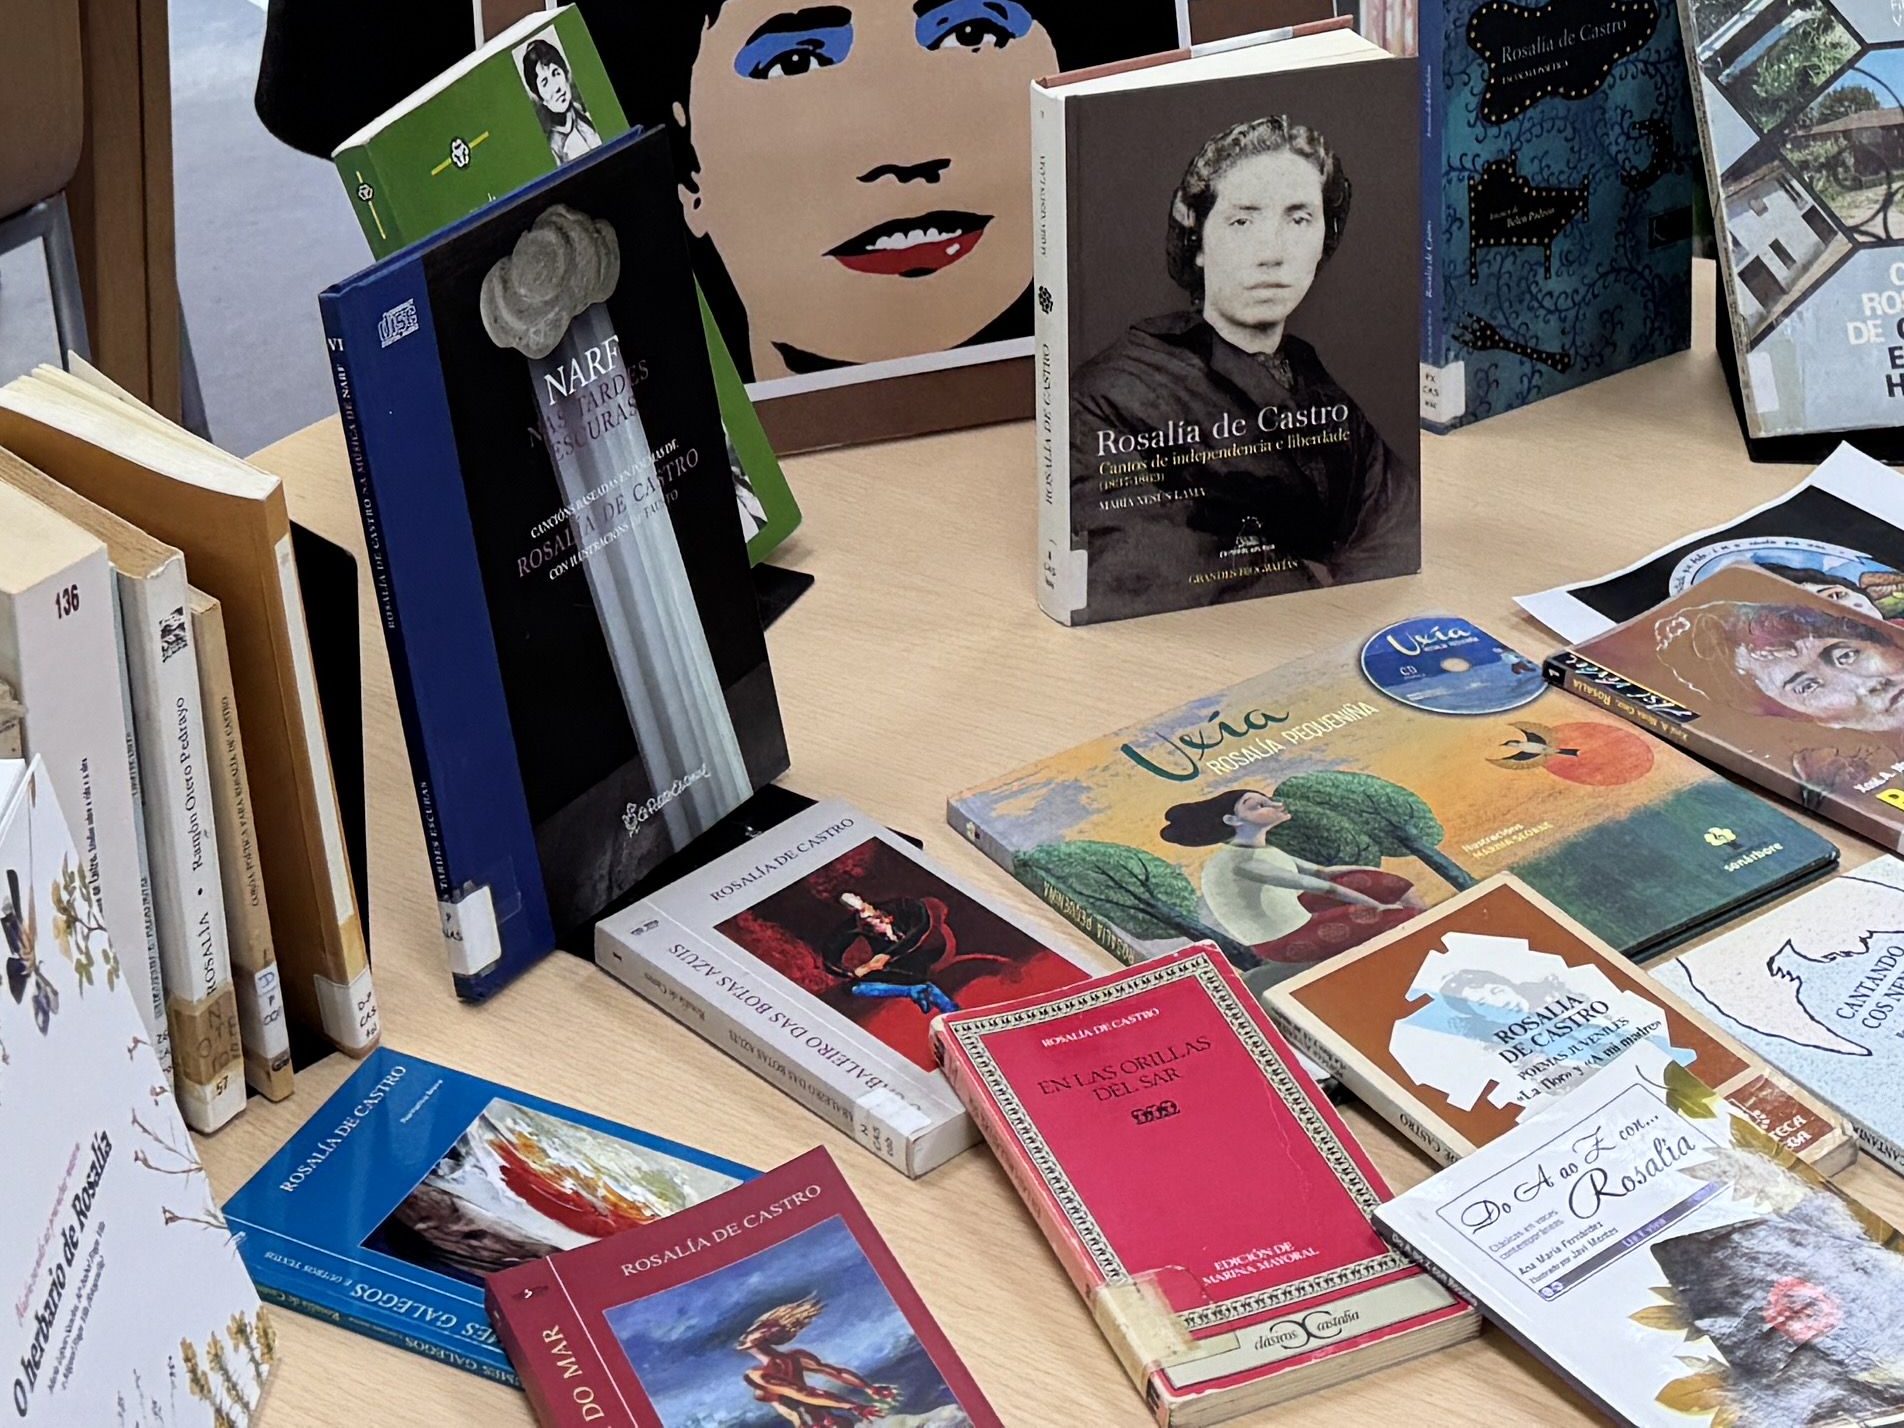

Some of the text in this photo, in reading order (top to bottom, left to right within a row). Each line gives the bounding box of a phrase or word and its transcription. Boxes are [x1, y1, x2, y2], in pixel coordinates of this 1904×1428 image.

[1847, 316, 1885, 346] DE
[544, 335, 619, 405] NARF
[1098, 404, 1348, 456] Rosalía de Castro
[1100, 460, 1147, 475] Cantos
[1151, 454, 1168, 468] de
[1173, 442, 1271, 465] independencia
[1276, 438, 1284, 449] e
[55, 584, 79, 619] 136
[1120, 704, 1290, 782] Uxía
[1206, 699, 1379, 776] ROSALÍA PEQUENIÑA
[709, 816, 855, 902] ROSALÍA DE CASTRO
[669, 943, 808, 1038] DAS BOTAS AZUIS
[1836, 946, 1904, 1019] CANTANDO
[1040, 1029, 1091, 1048] ROSALÍA
[1109, 1007, 1160, 1030] CASTRO
[1494, 995, 1584, 1045] ROSALIA
[1498, 1000, 1609, 1064] DE CASTRO
[1862, 1001, 1894, 1029] COS
[1037, 1035, 1212, 1096] EN LAS ORILLAS
[1517, 1017, 1629, 1081] POEMAS JUVENILES
[1093, 1066, 1182, 1103] DEL SAR
[279, 1064, 407, 1195] ROSALÍA DE CASTRO
[1568, 1129, 1696, 1220] Rosalía
[620, 1183, 823, 1277] ROSALÍA DE CASTRO
[1461, 1198, 1513, 1235] Do
[13, 1129, 112, 1418] O herbario de Rosalía
[1202, 1246, 1319, 1287] MARINA MAYORAL
[1213, 1241, 1294, 1273] EDICIÓN DE
[541, 1324, 608, 1422] DO MAR
